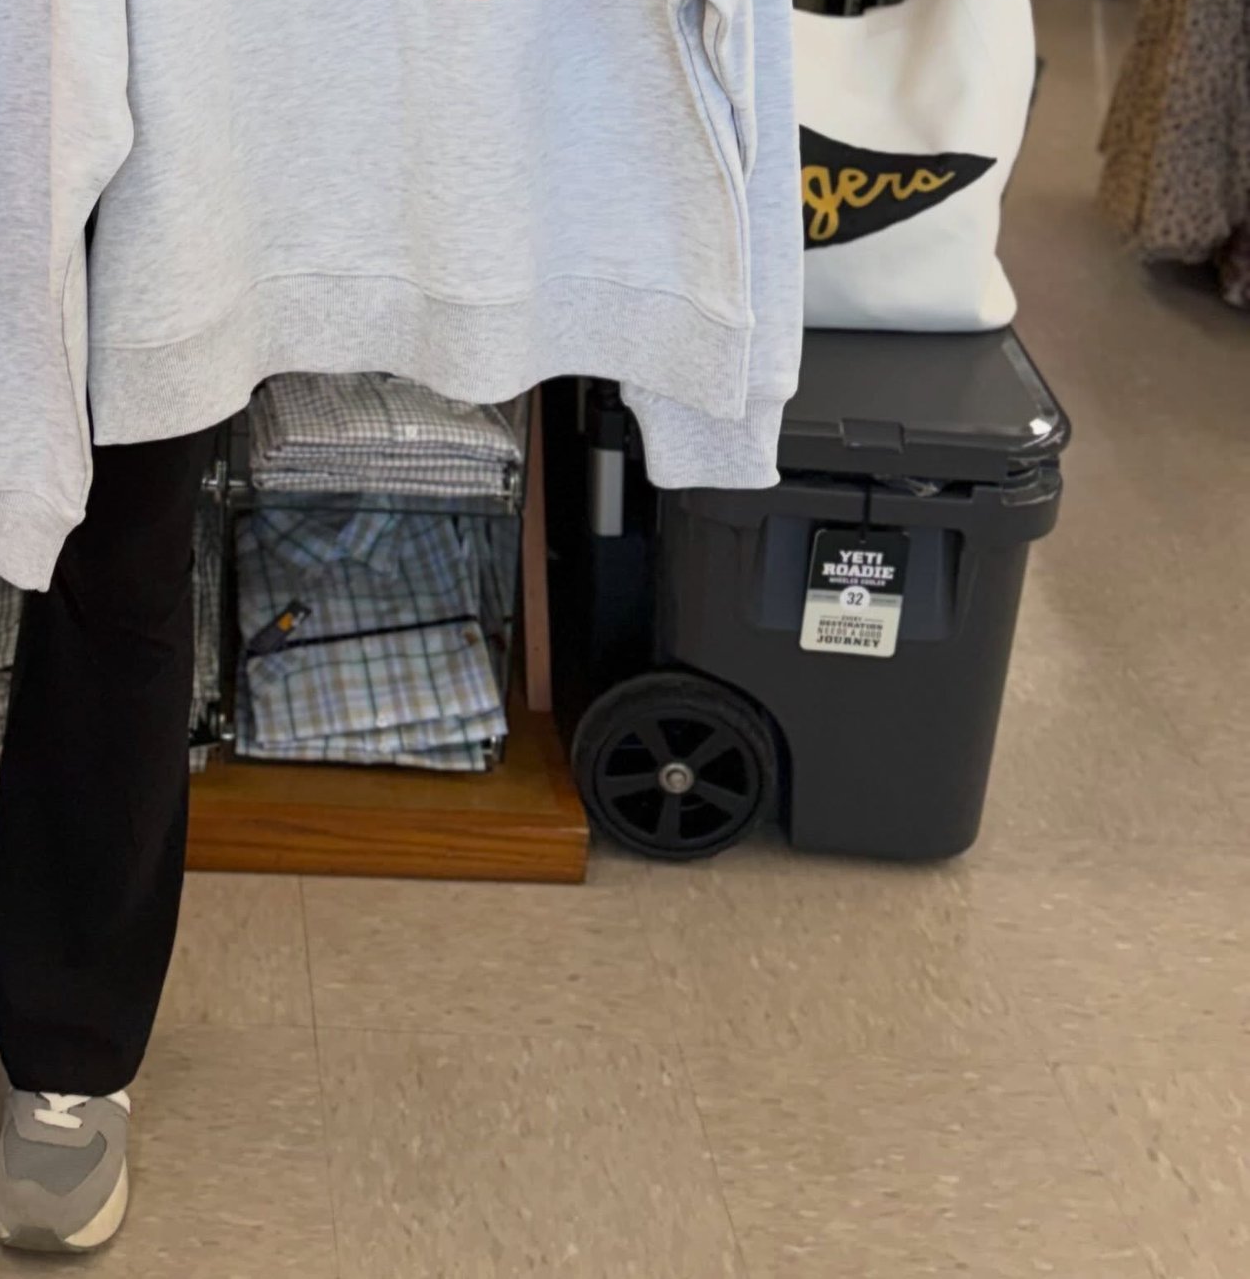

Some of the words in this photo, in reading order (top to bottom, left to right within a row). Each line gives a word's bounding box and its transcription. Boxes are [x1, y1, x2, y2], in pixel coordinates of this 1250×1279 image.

[801, 165, 956, 241] gers
[839, 550, 884, 565] YETI
[822, 563, 895, 580] ROADIE
[846, 592, 864, 606] 32
[817, 636, 880, 648] JOURNEY
